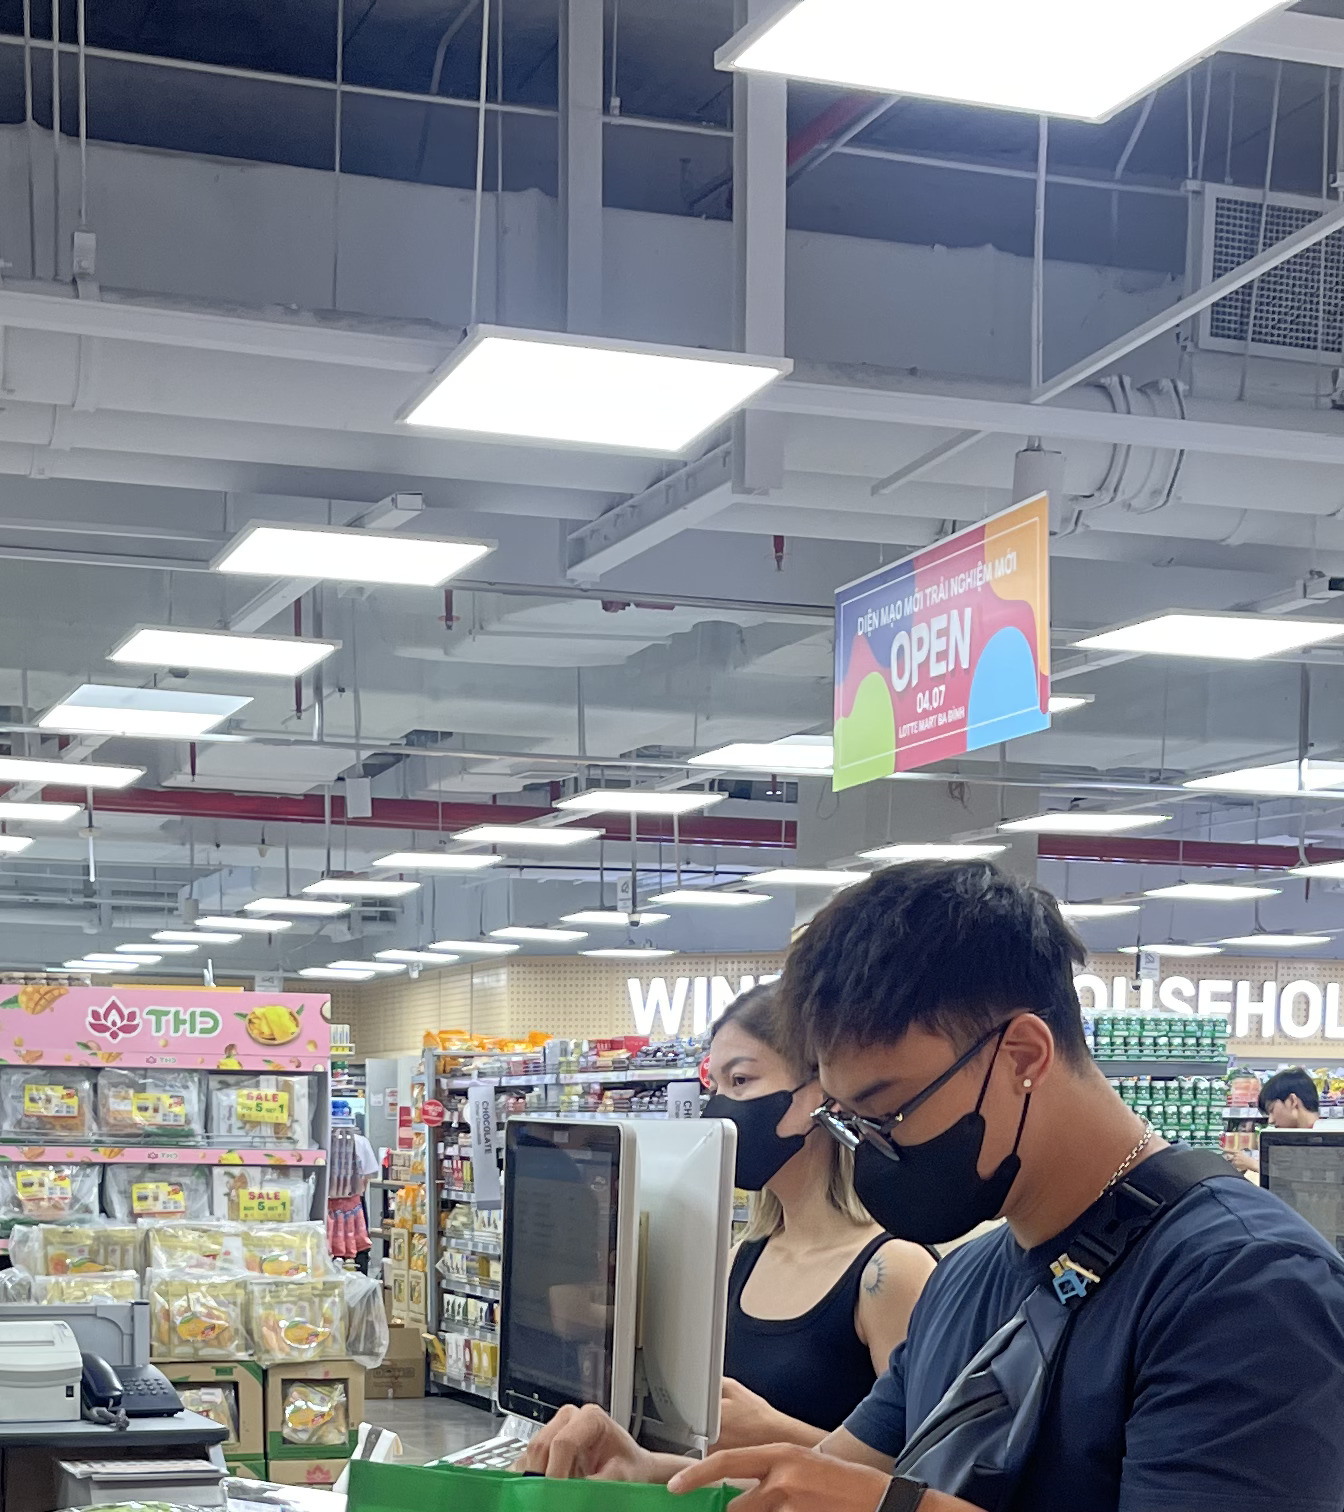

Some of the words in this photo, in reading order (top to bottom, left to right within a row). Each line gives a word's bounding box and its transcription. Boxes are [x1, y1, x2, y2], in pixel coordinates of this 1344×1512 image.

[857, 609, 881, 637] DIỆN
[950, 557, 992, 597] NGHIỆM
[890, 607, 973, 693] OPEN
[248, 1191, 280, 1200] SALE
